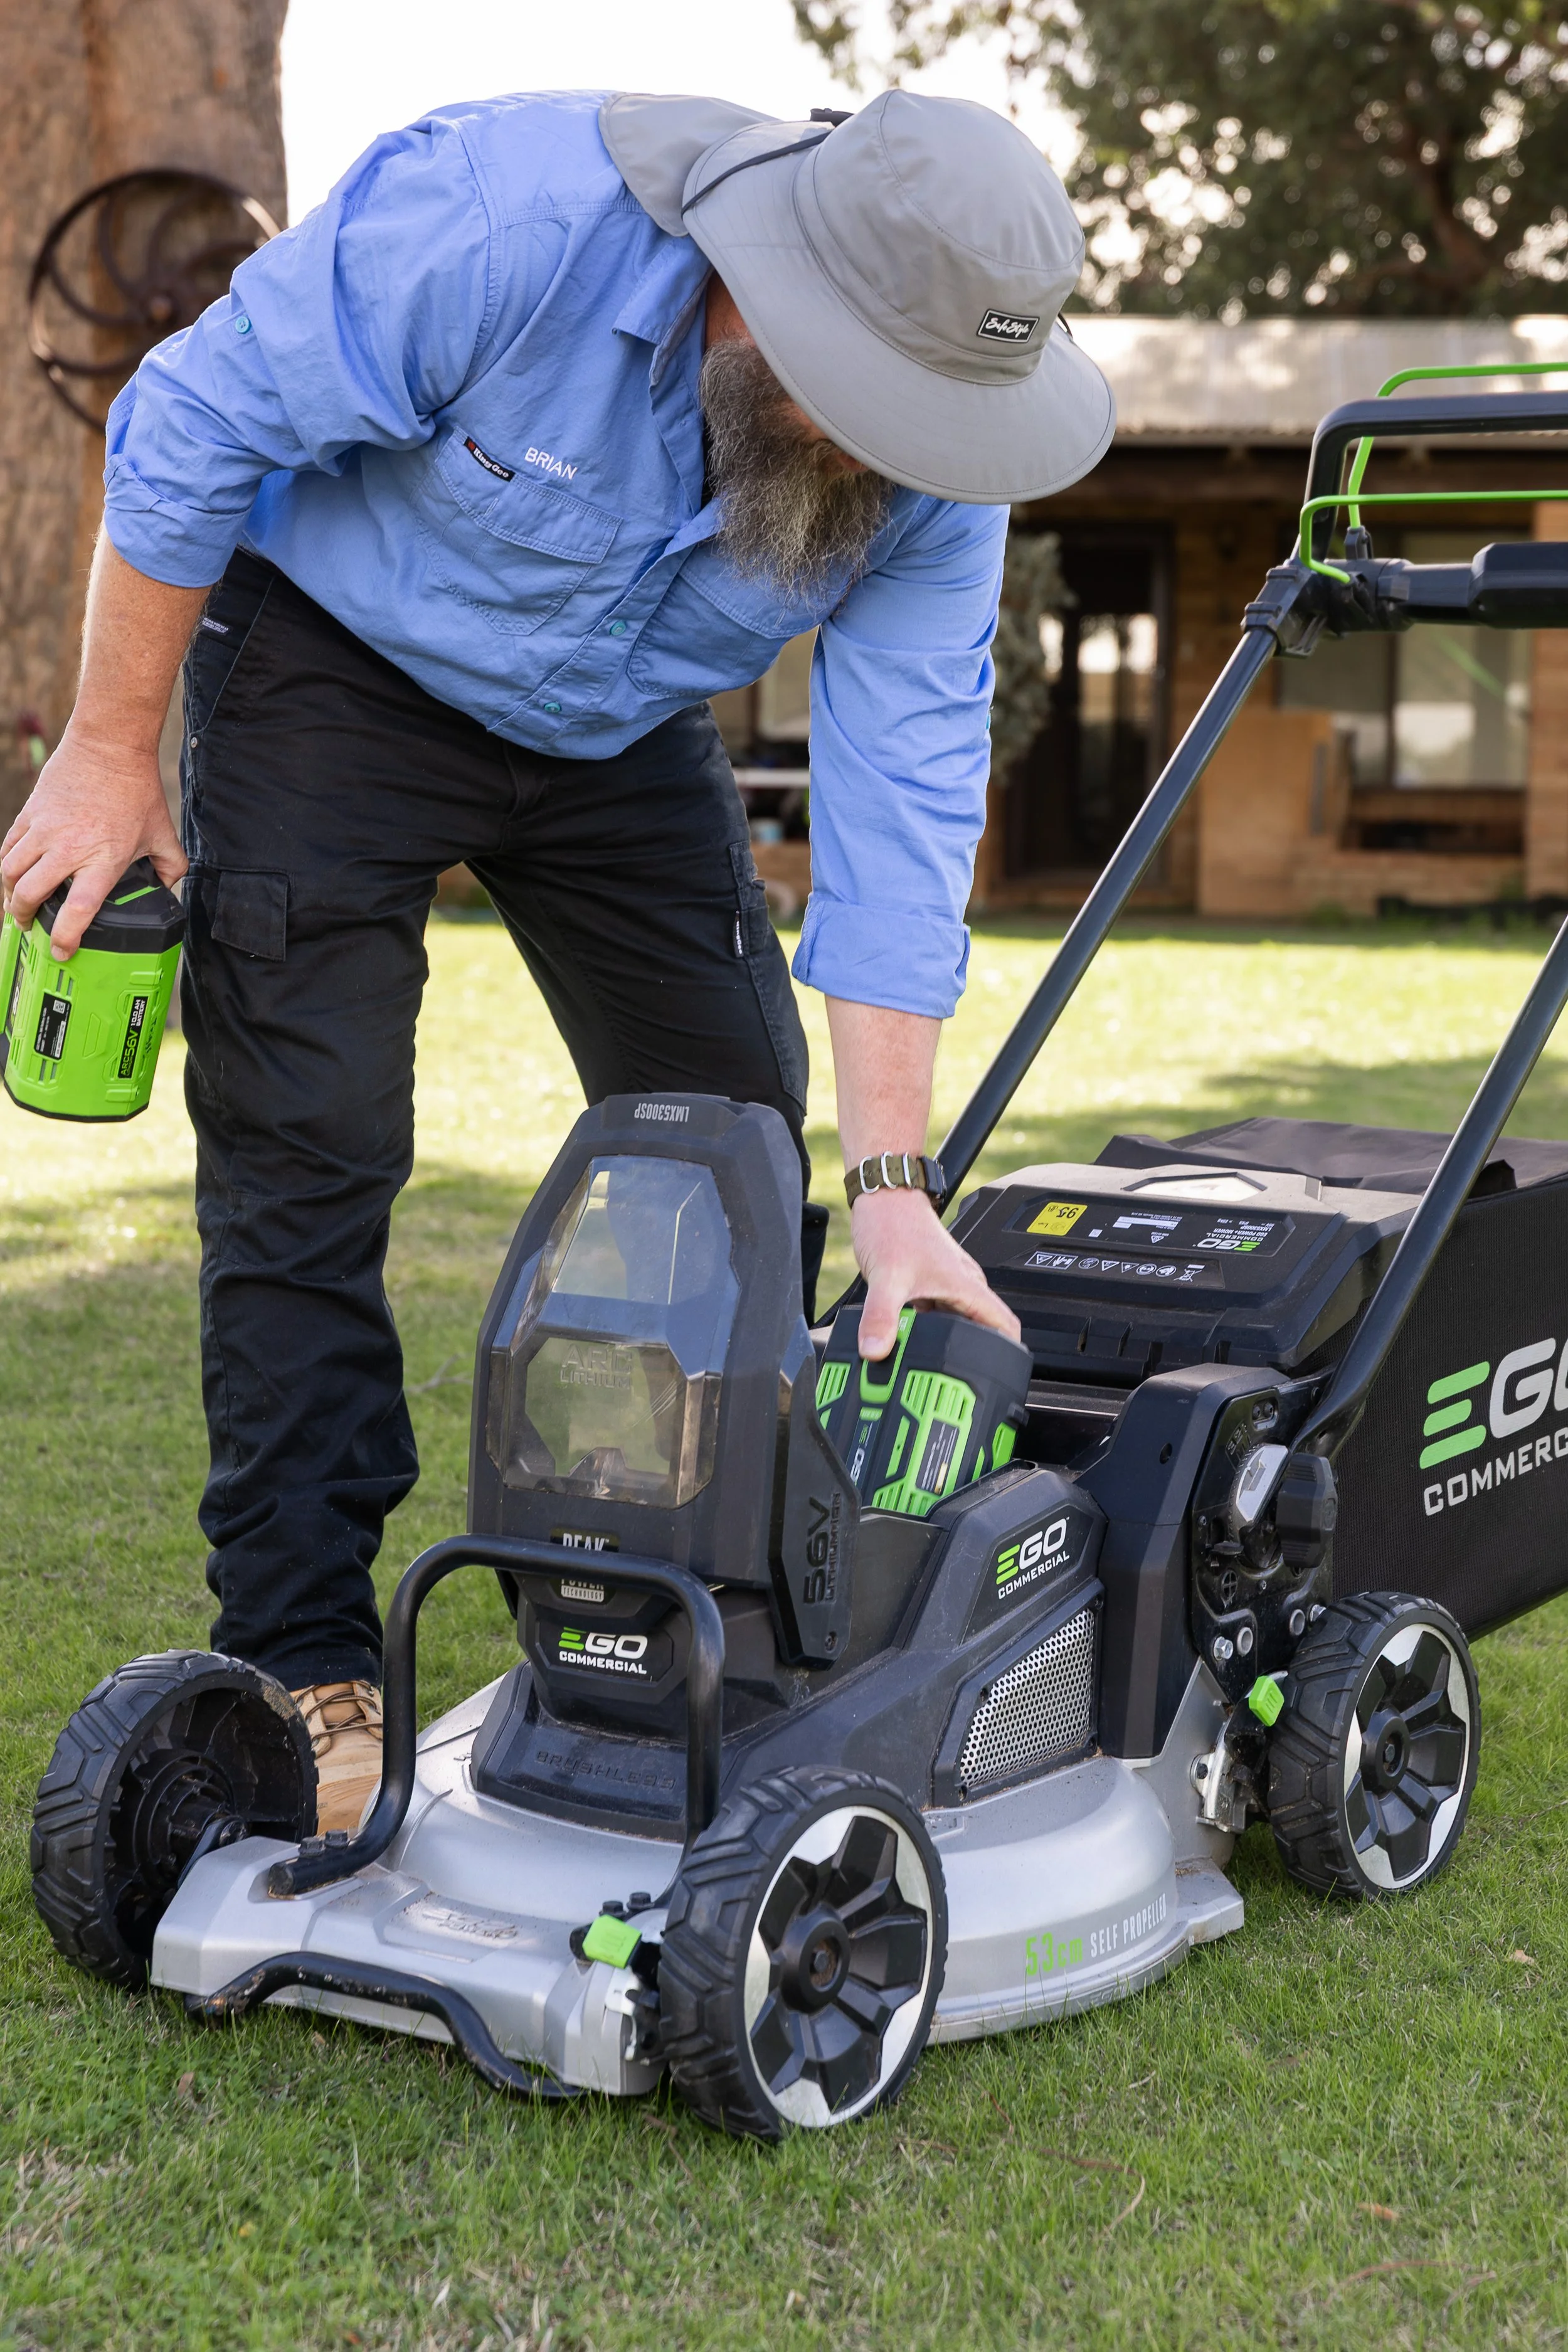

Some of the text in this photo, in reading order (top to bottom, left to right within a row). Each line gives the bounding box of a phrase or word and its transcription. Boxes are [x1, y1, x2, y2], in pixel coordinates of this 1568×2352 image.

[524, 447, 578, 480] BRIAN
[135, 1000, 146, 1027] BATTERY
[125, 1029, 139, 1056] 56V
[120, 1055, 130, 1076] ARC
[633, 1103, 690, 1123] LMX5300SP
[1056, 1206, 1079, 1219] 95
[1197, 1237, 1261, 1253] EGO
[1205, 1232, 1264, 1242] COMMERCIAL
[1419, 1337, 1568, 1470] EG
[803, 1495, 830, 1604] 56V
[996, 1518, 1068, 1586] EGO
[997, 1550, 1070, 1600] COMMERCIAL
[562, 1587, 603, 1601] TECHNOLOGY
[558, 1626, 649, 1660] EGO
[558, 1650, 647, 1675] COMMERCIAL
[534, 1750, 676, 1790] BRUSHLESS
[1025, 1892, 1167, 1976] 53cm SELF PROPELLED
